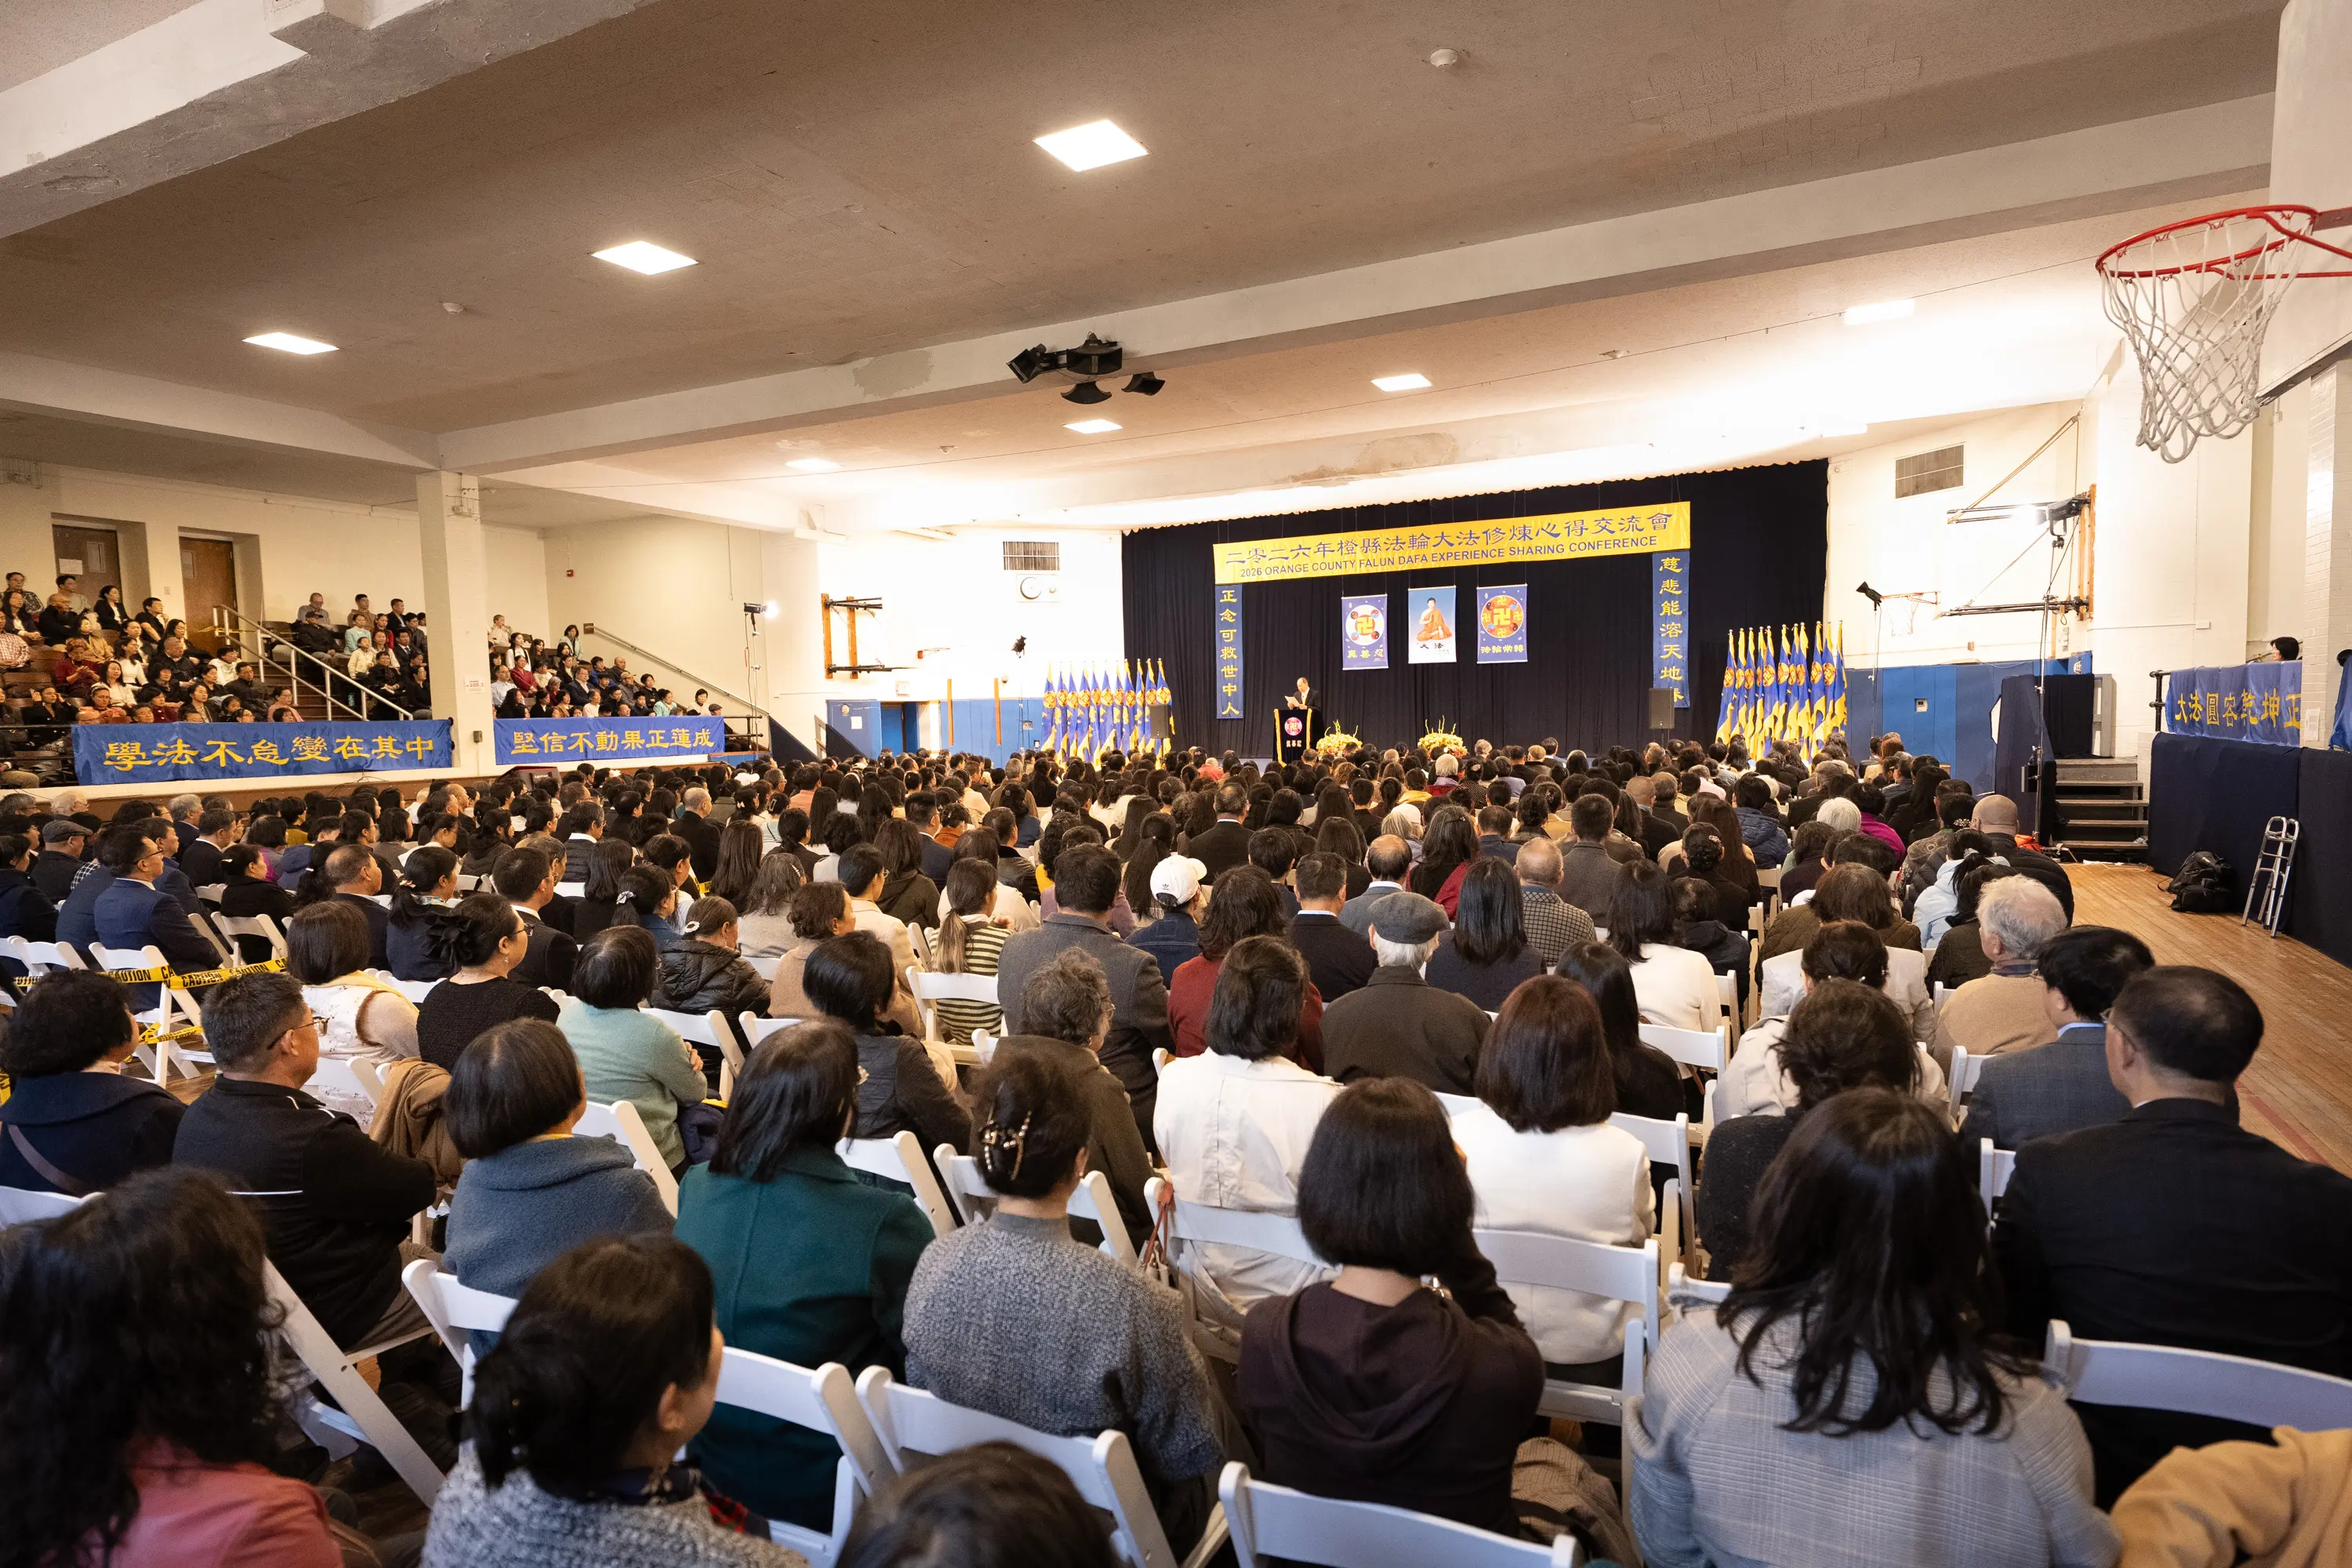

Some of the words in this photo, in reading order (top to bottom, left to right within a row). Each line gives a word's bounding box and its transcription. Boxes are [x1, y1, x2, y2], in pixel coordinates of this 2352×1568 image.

[1225, 512, 1673, 564] 二零二六年橙縣法輪大法修煉心得交流會
[1240, 567, 1262, 578] 2026
[1265, 563, 1308, 575] ORANGE
[1312, 560, 1355, 571] COUNTY
[1359, 557, 1395, 568] FALUN
[1399, 554, 1427, 565] DAFA
[1432, 548, 1504, 562] EXPERIENCE
[1509, 543, 1565, 557] SHARING
[1569, 535, 1657, 551] CONFERENCE
[1219, 590, 1240, 715] 正念可救世中人
[2174, 688, 2302, 730] 大法圓容乾坤正
[103, 735, 434, 772] 學法不怠變在其中
[510, 728, 715, 755] 堅信不動果正蓮成
[181, 972, 223, 988] CAUTION
